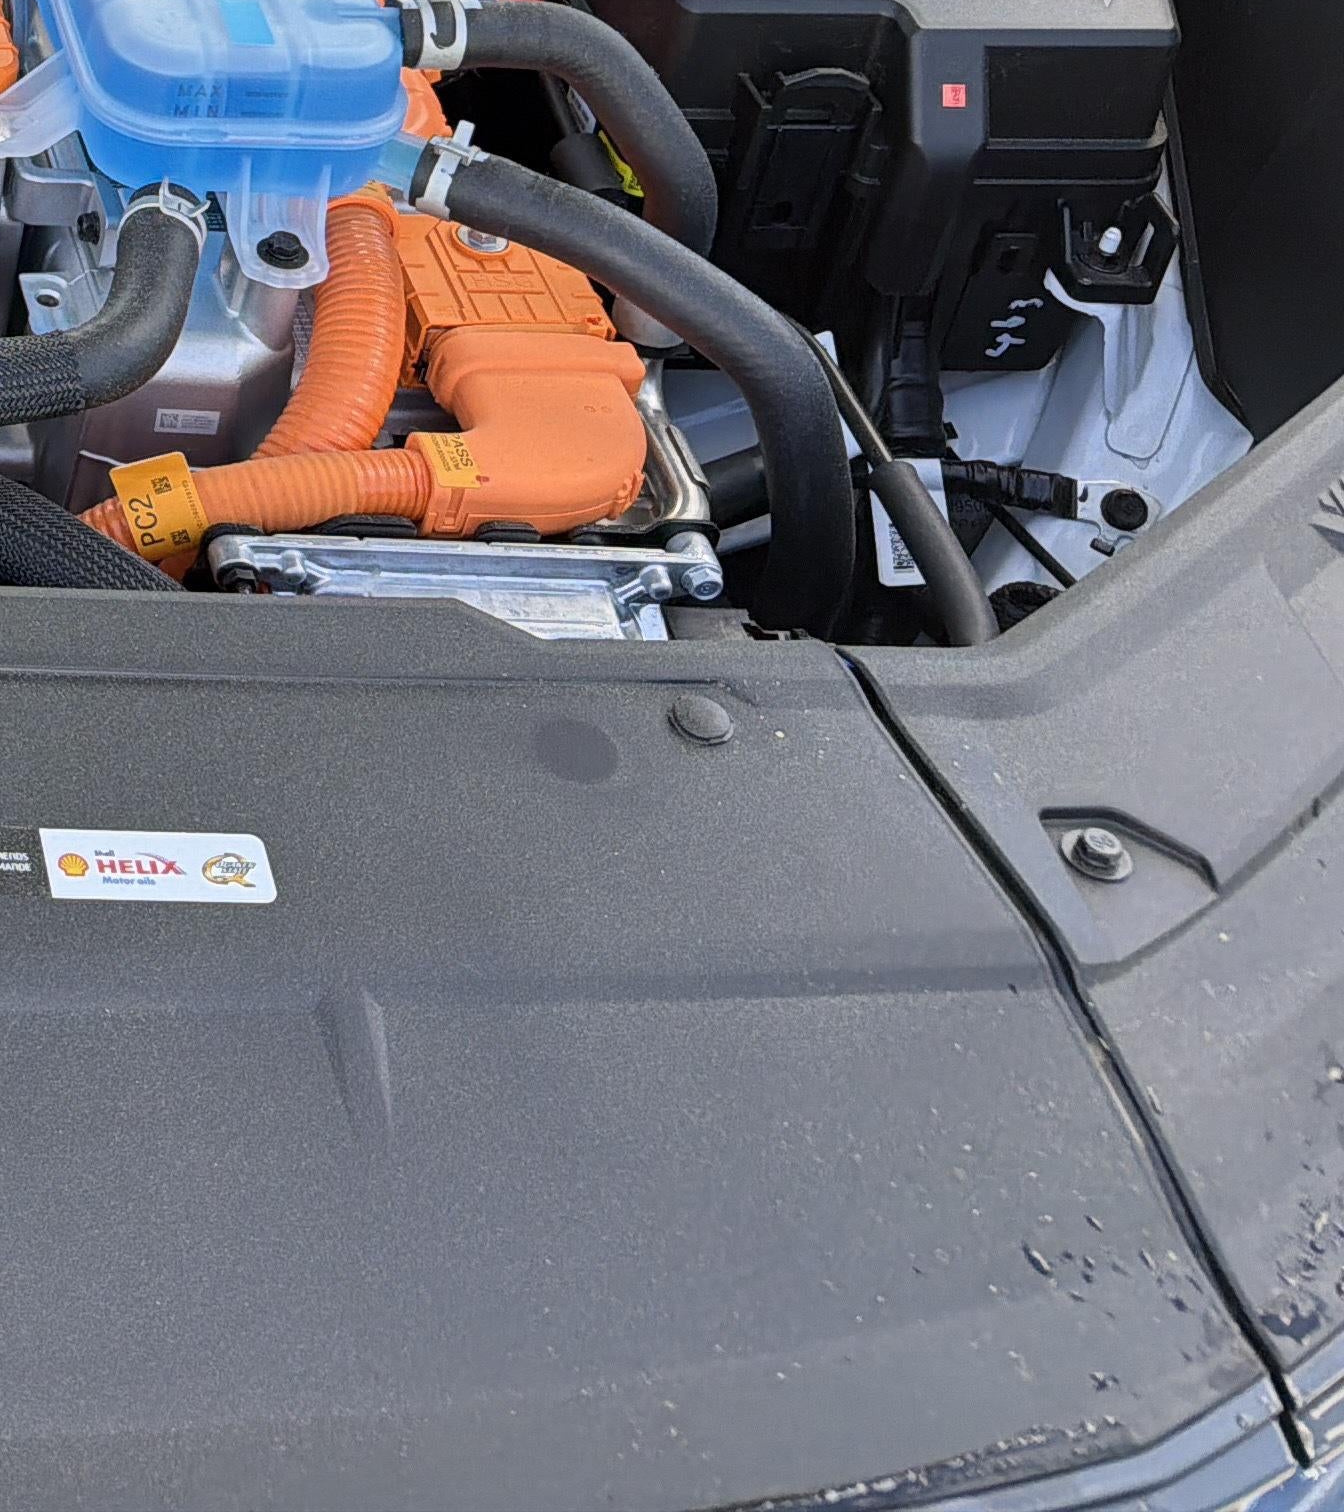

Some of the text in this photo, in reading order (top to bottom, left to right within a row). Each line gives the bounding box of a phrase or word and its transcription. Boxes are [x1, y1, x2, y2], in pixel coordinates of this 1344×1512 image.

[176, 82, 225, 98] MAX
[174, 103, 220, 118] MIN
[128, 494, 166, 547] PC2
[96, 859, 183, 875] HELIX
[102, 876, 135, 885] Motor
